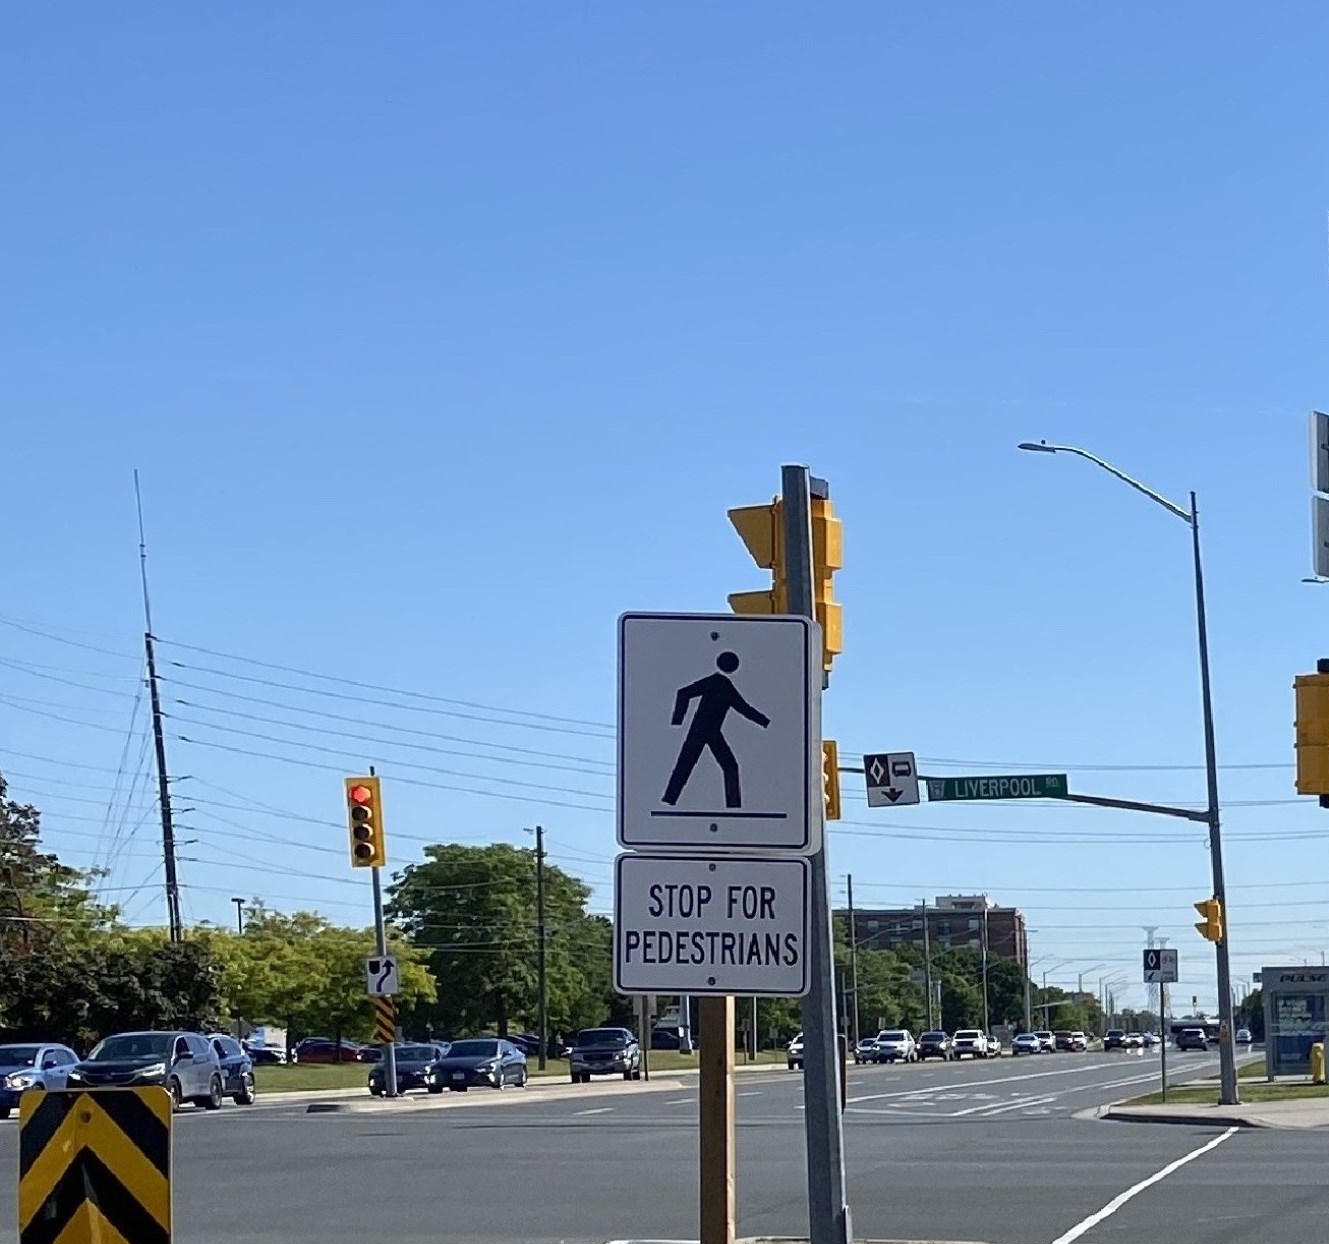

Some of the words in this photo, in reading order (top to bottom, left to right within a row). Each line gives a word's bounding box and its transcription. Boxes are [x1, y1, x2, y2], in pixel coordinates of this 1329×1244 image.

[955, 778, 1041, 797] LIVERPOOL
[648, 884, 712, 918] STOP
[728, 886, 776, 919] FOR
[625, 930, 798, 966] PEDESTRIANS
